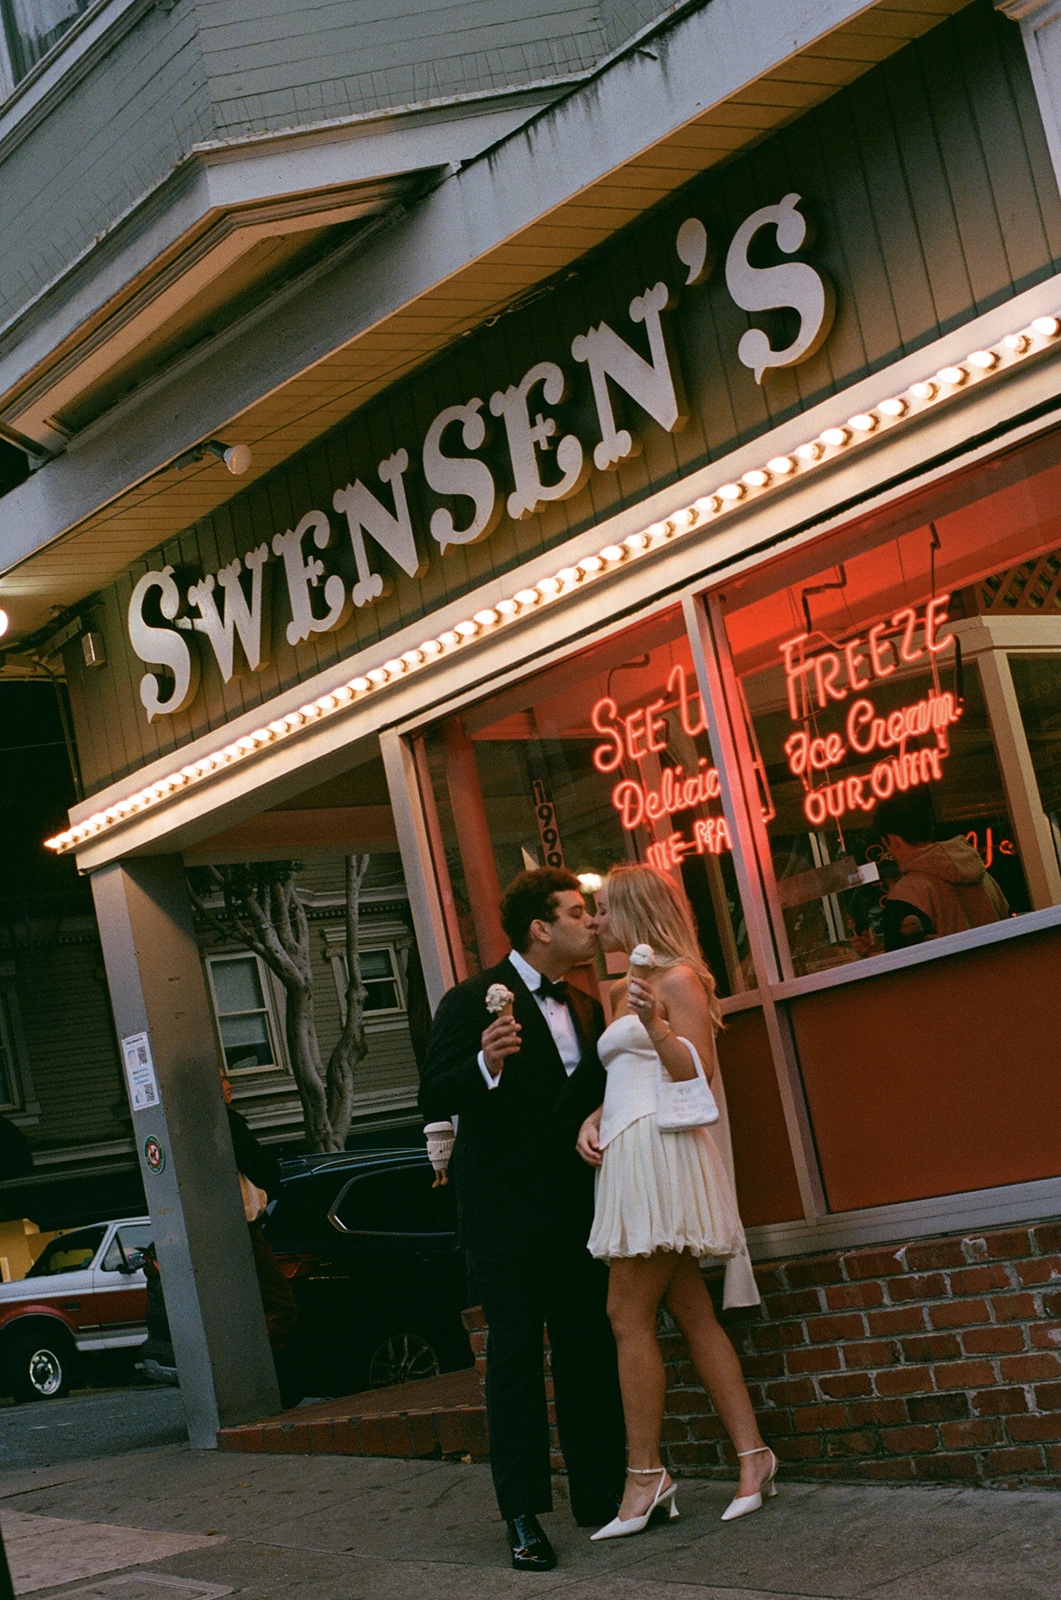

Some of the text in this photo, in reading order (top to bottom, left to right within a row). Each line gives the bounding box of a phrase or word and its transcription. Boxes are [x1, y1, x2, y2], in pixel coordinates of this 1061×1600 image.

[128, 192, 834, 723] SWENSEN'S
[591, 593, 953, 773] SEE U FREEZE
[535, 780, 562, 868] 1999
[613, 692, 963, 830] Delicio Ice Cream
[646, 747, 943, 870] WE MA OUR OWN
